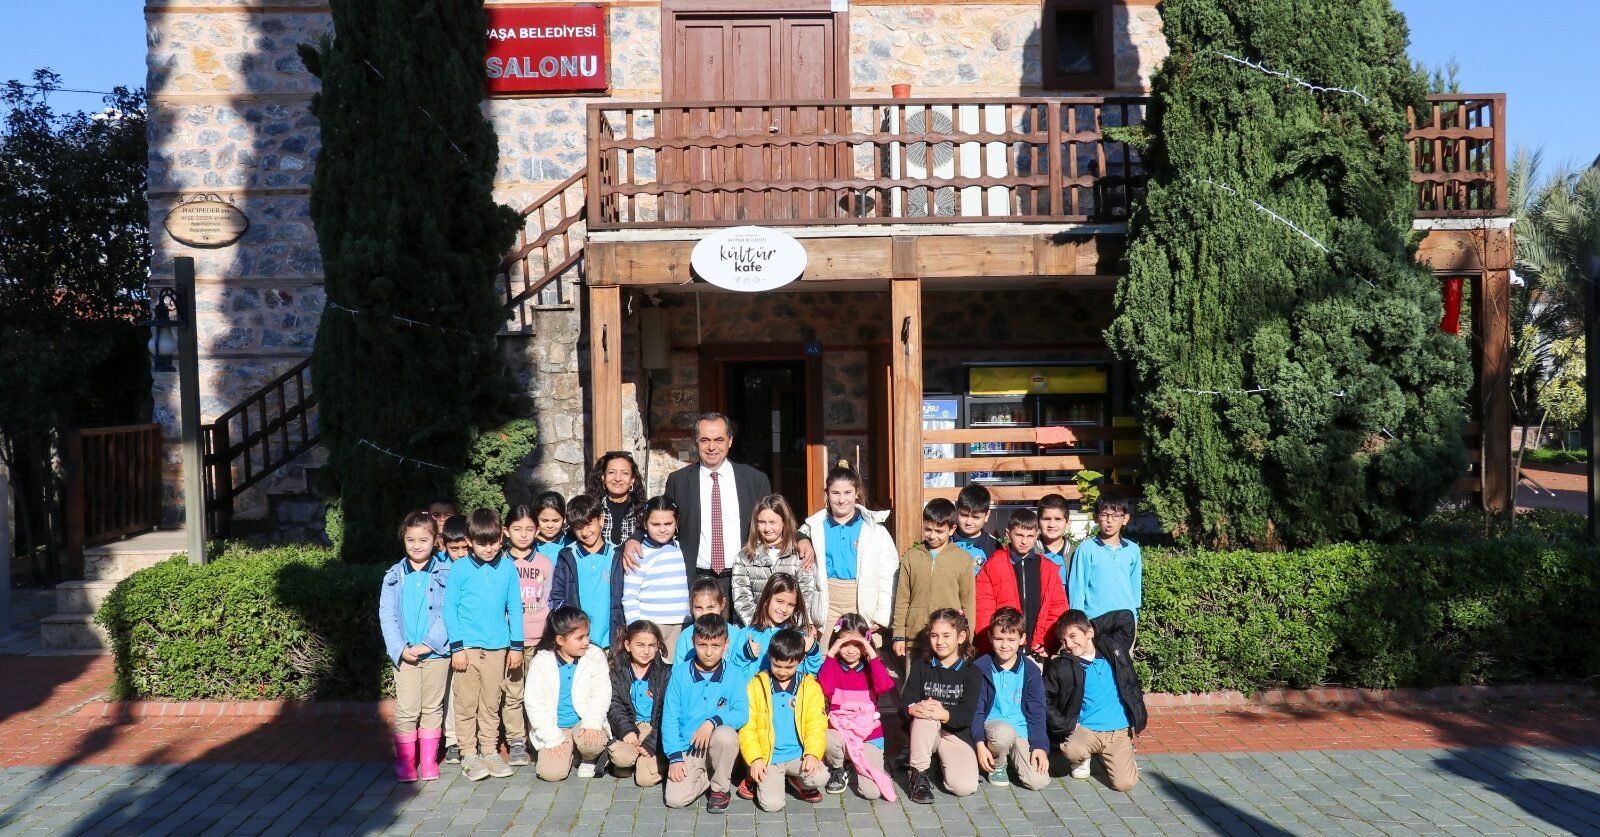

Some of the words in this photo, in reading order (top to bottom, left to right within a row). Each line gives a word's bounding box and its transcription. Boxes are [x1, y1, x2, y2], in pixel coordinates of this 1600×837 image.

[519, 24, 597, 39] BELEDİYESİ
[486, 56, 598, 78] SALONU
[720, 245, 777, 263] kültür
[734, 262, 762, 272] kafe
